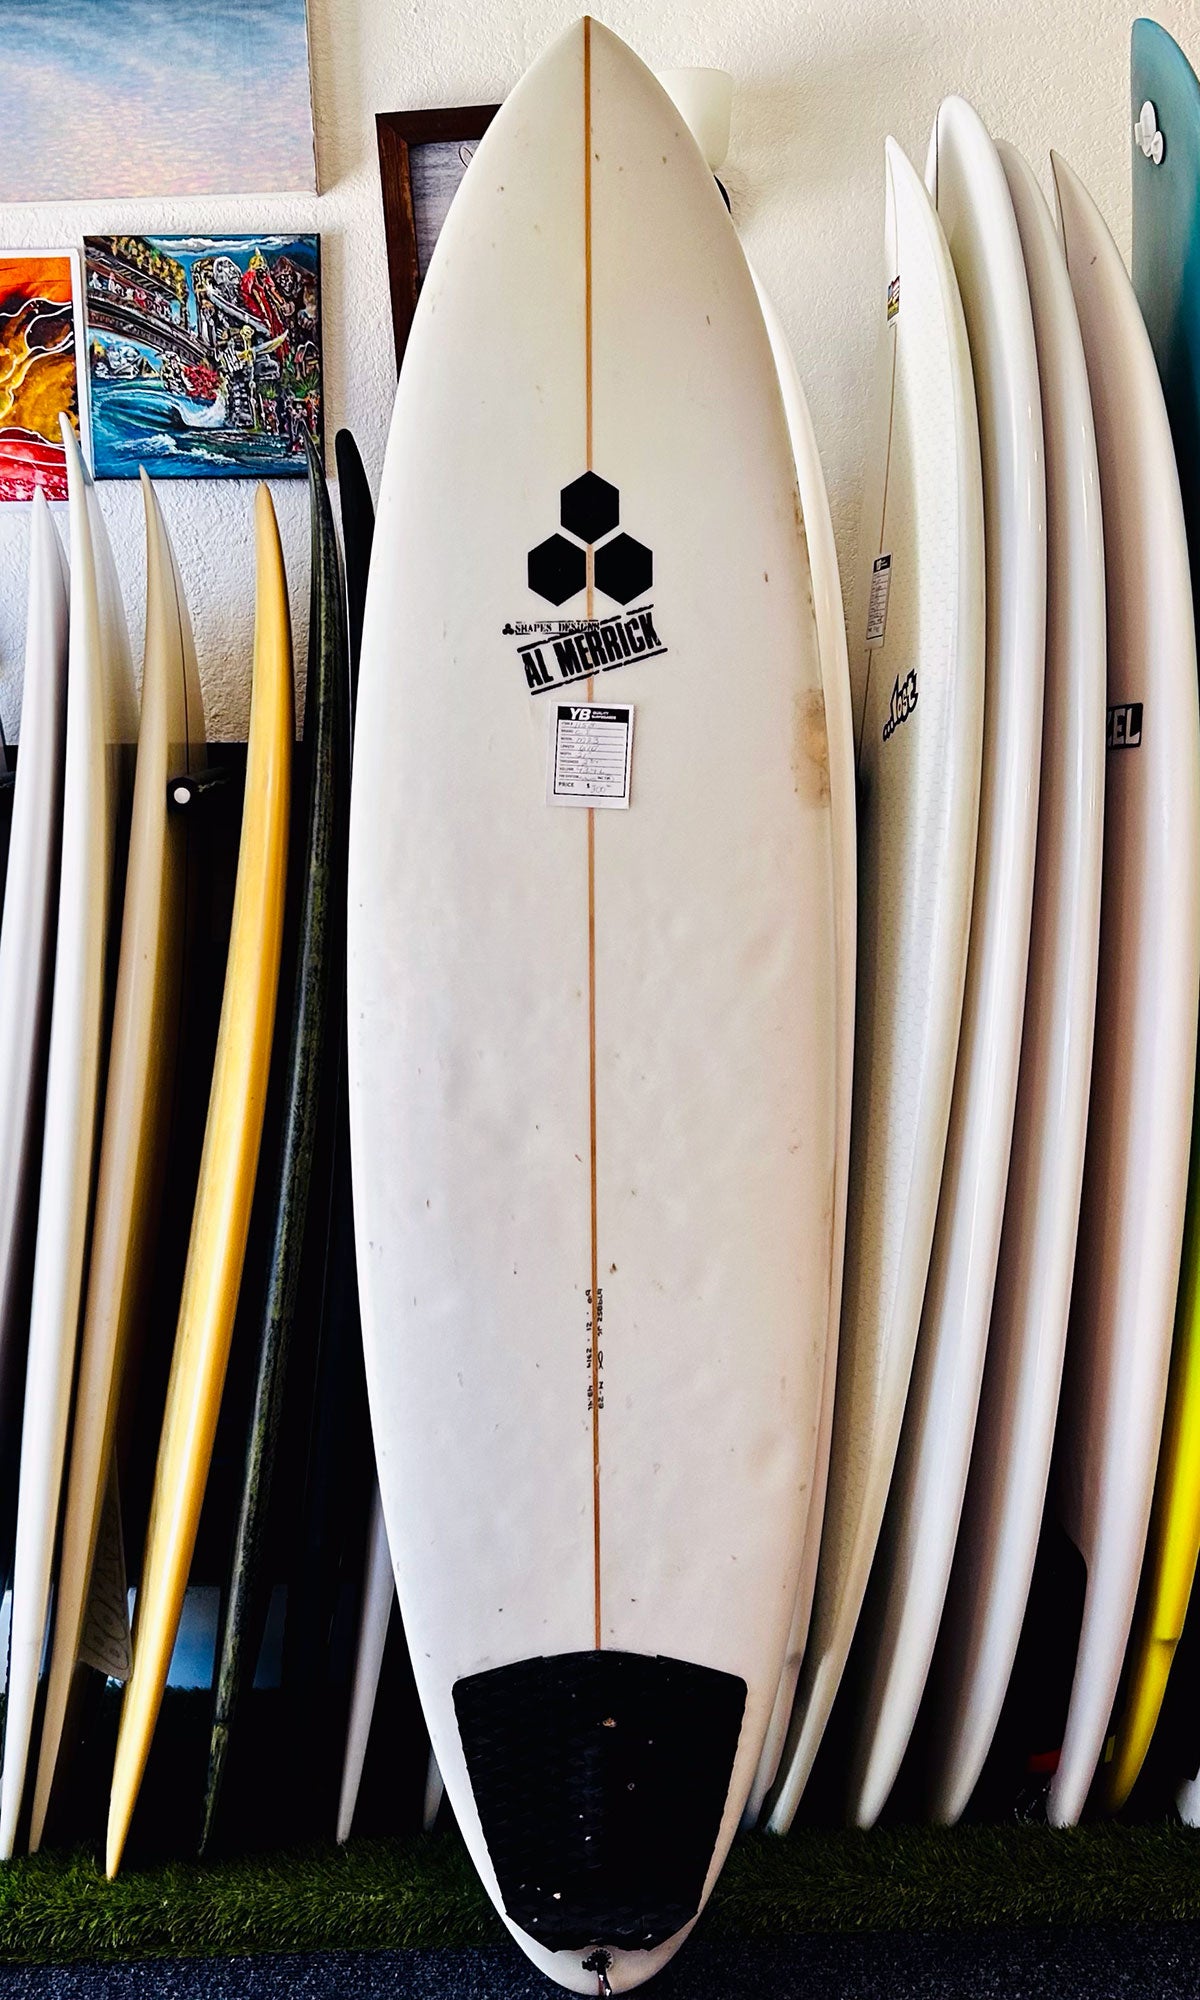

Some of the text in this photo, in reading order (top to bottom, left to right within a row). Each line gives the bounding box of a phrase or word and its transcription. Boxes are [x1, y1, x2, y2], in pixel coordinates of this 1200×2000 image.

[515, 622, 552, 634] SHAPES
[521, 611, 663, 689] AL MERRICK
[570, 707, 592, 721] YB
